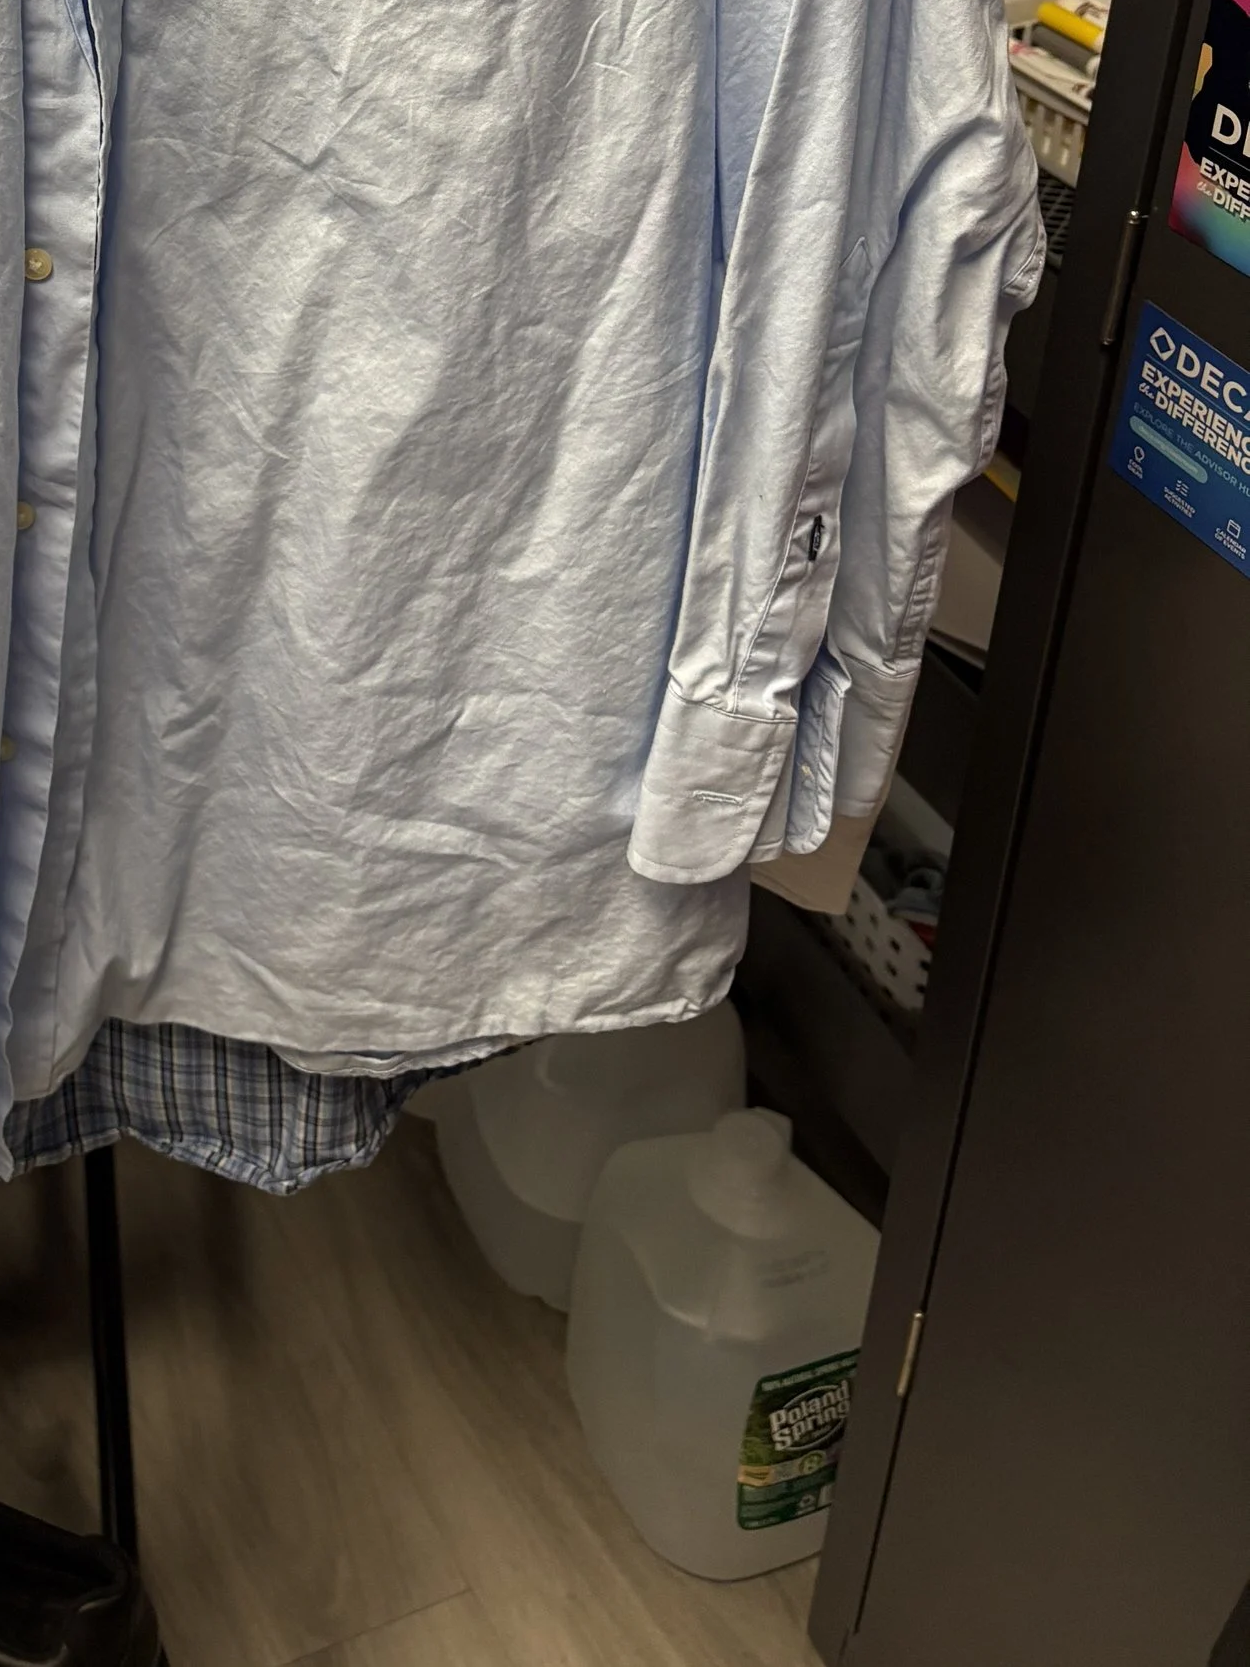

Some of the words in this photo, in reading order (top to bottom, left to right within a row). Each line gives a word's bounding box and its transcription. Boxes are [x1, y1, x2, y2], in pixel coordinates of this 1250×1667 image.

[1176, 343, 1250, 422] DEC
[1134, 401, 1174, 438] EXPLORE
[1176, 435, 1195, 453] THE
[1194, 450, 1238, 487] ADVISOR
[1215, 527, 1247, 554] CALENDAR
[1222, 539, 1246, 560] EVENTS
[769, 1379, 851, 1433] Poland
[771, 1399, 850, 1451] Spring
